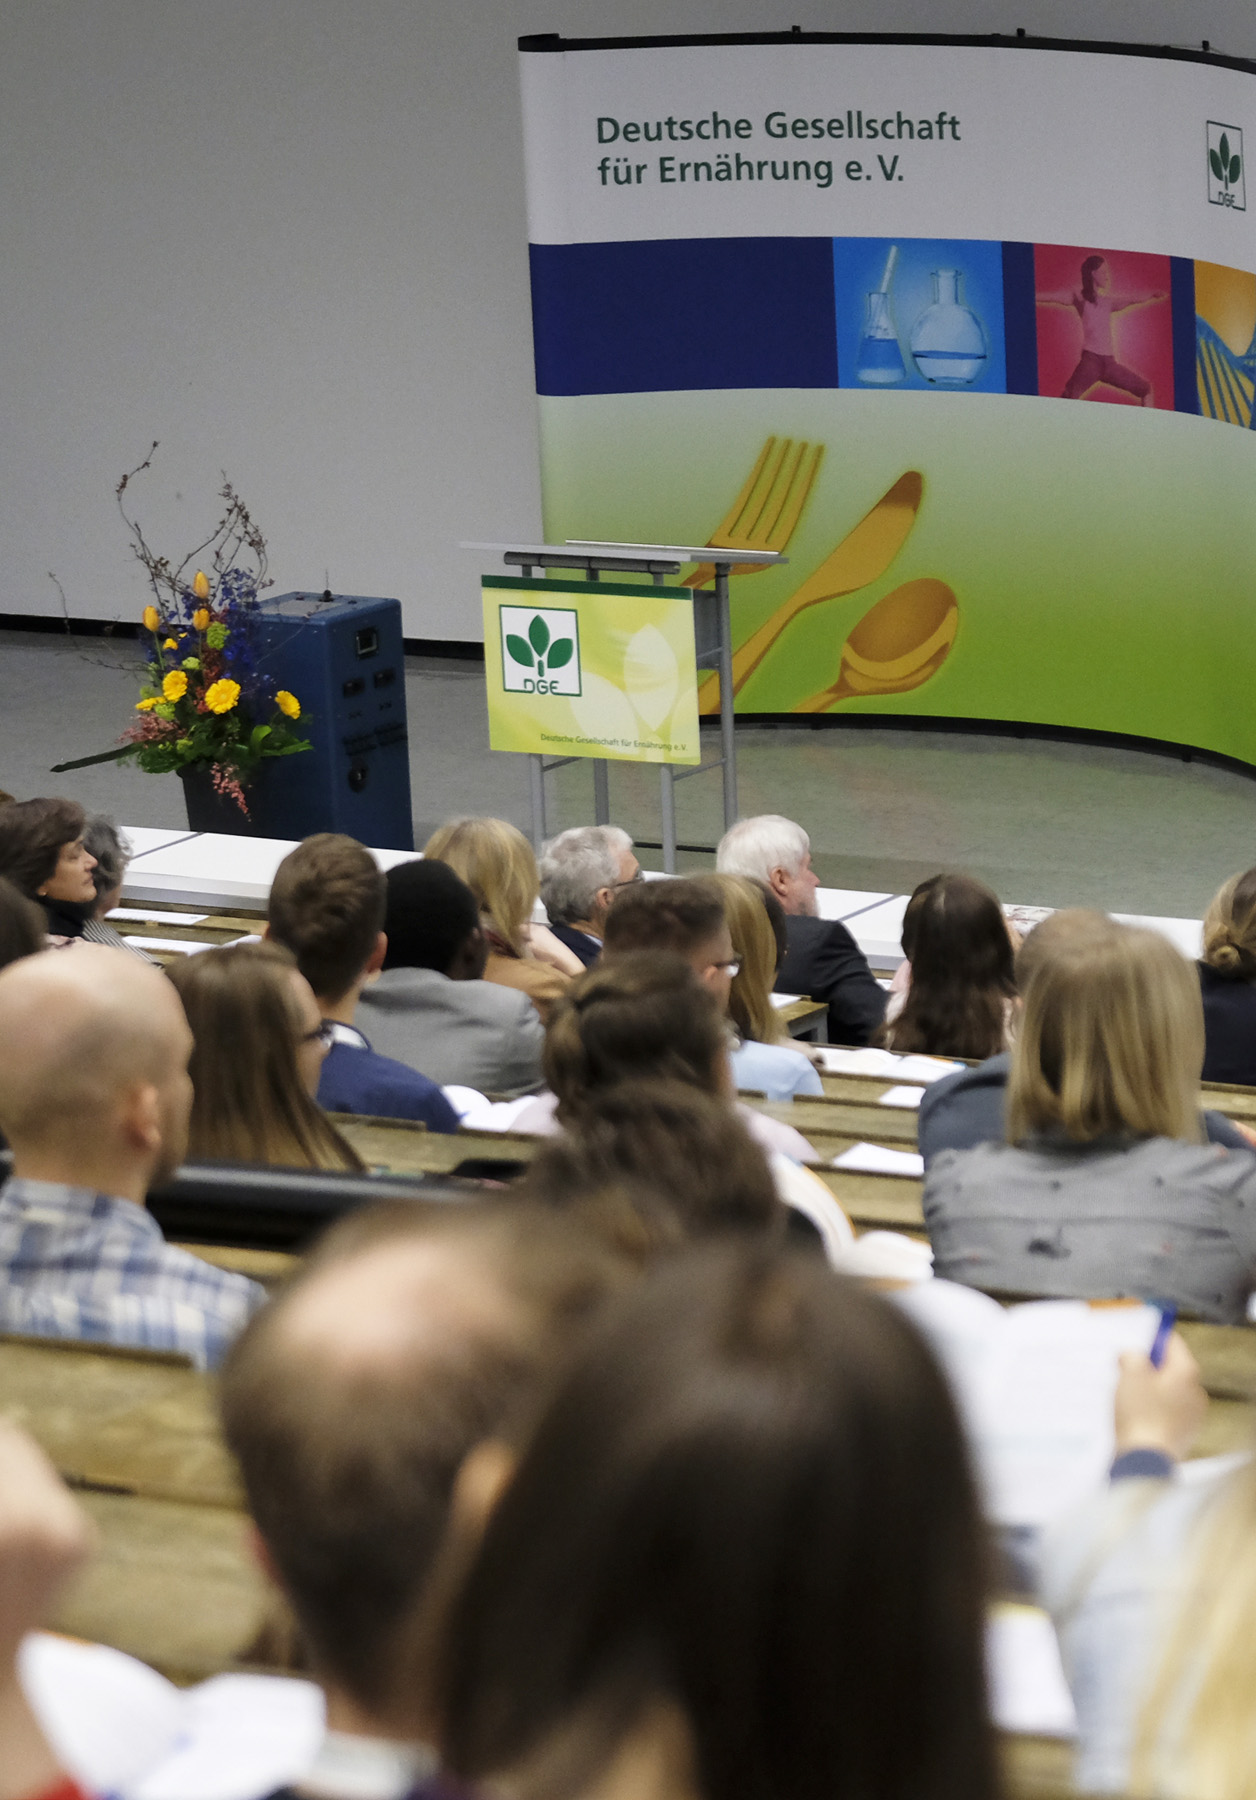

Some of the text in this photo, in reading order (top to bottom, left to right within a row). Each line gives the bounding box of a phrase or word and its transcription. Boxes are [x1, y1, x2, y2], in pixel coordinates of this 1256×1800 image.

[596, 110, 962, 144] Deutsche Gesellschaft
[597, 156, 648, 186] für
[658, 152, 833, 189] Ernährung
[1218, 191, 1236, 208] DGE
[523, 678, 560, 695] DGE
[540, 733, 574, 744] Deutsche
[575, 735, 619, 747] Gesellschaft
[620, 738, 632, 748] für
[633, 739, 673, 752] Ernährung
